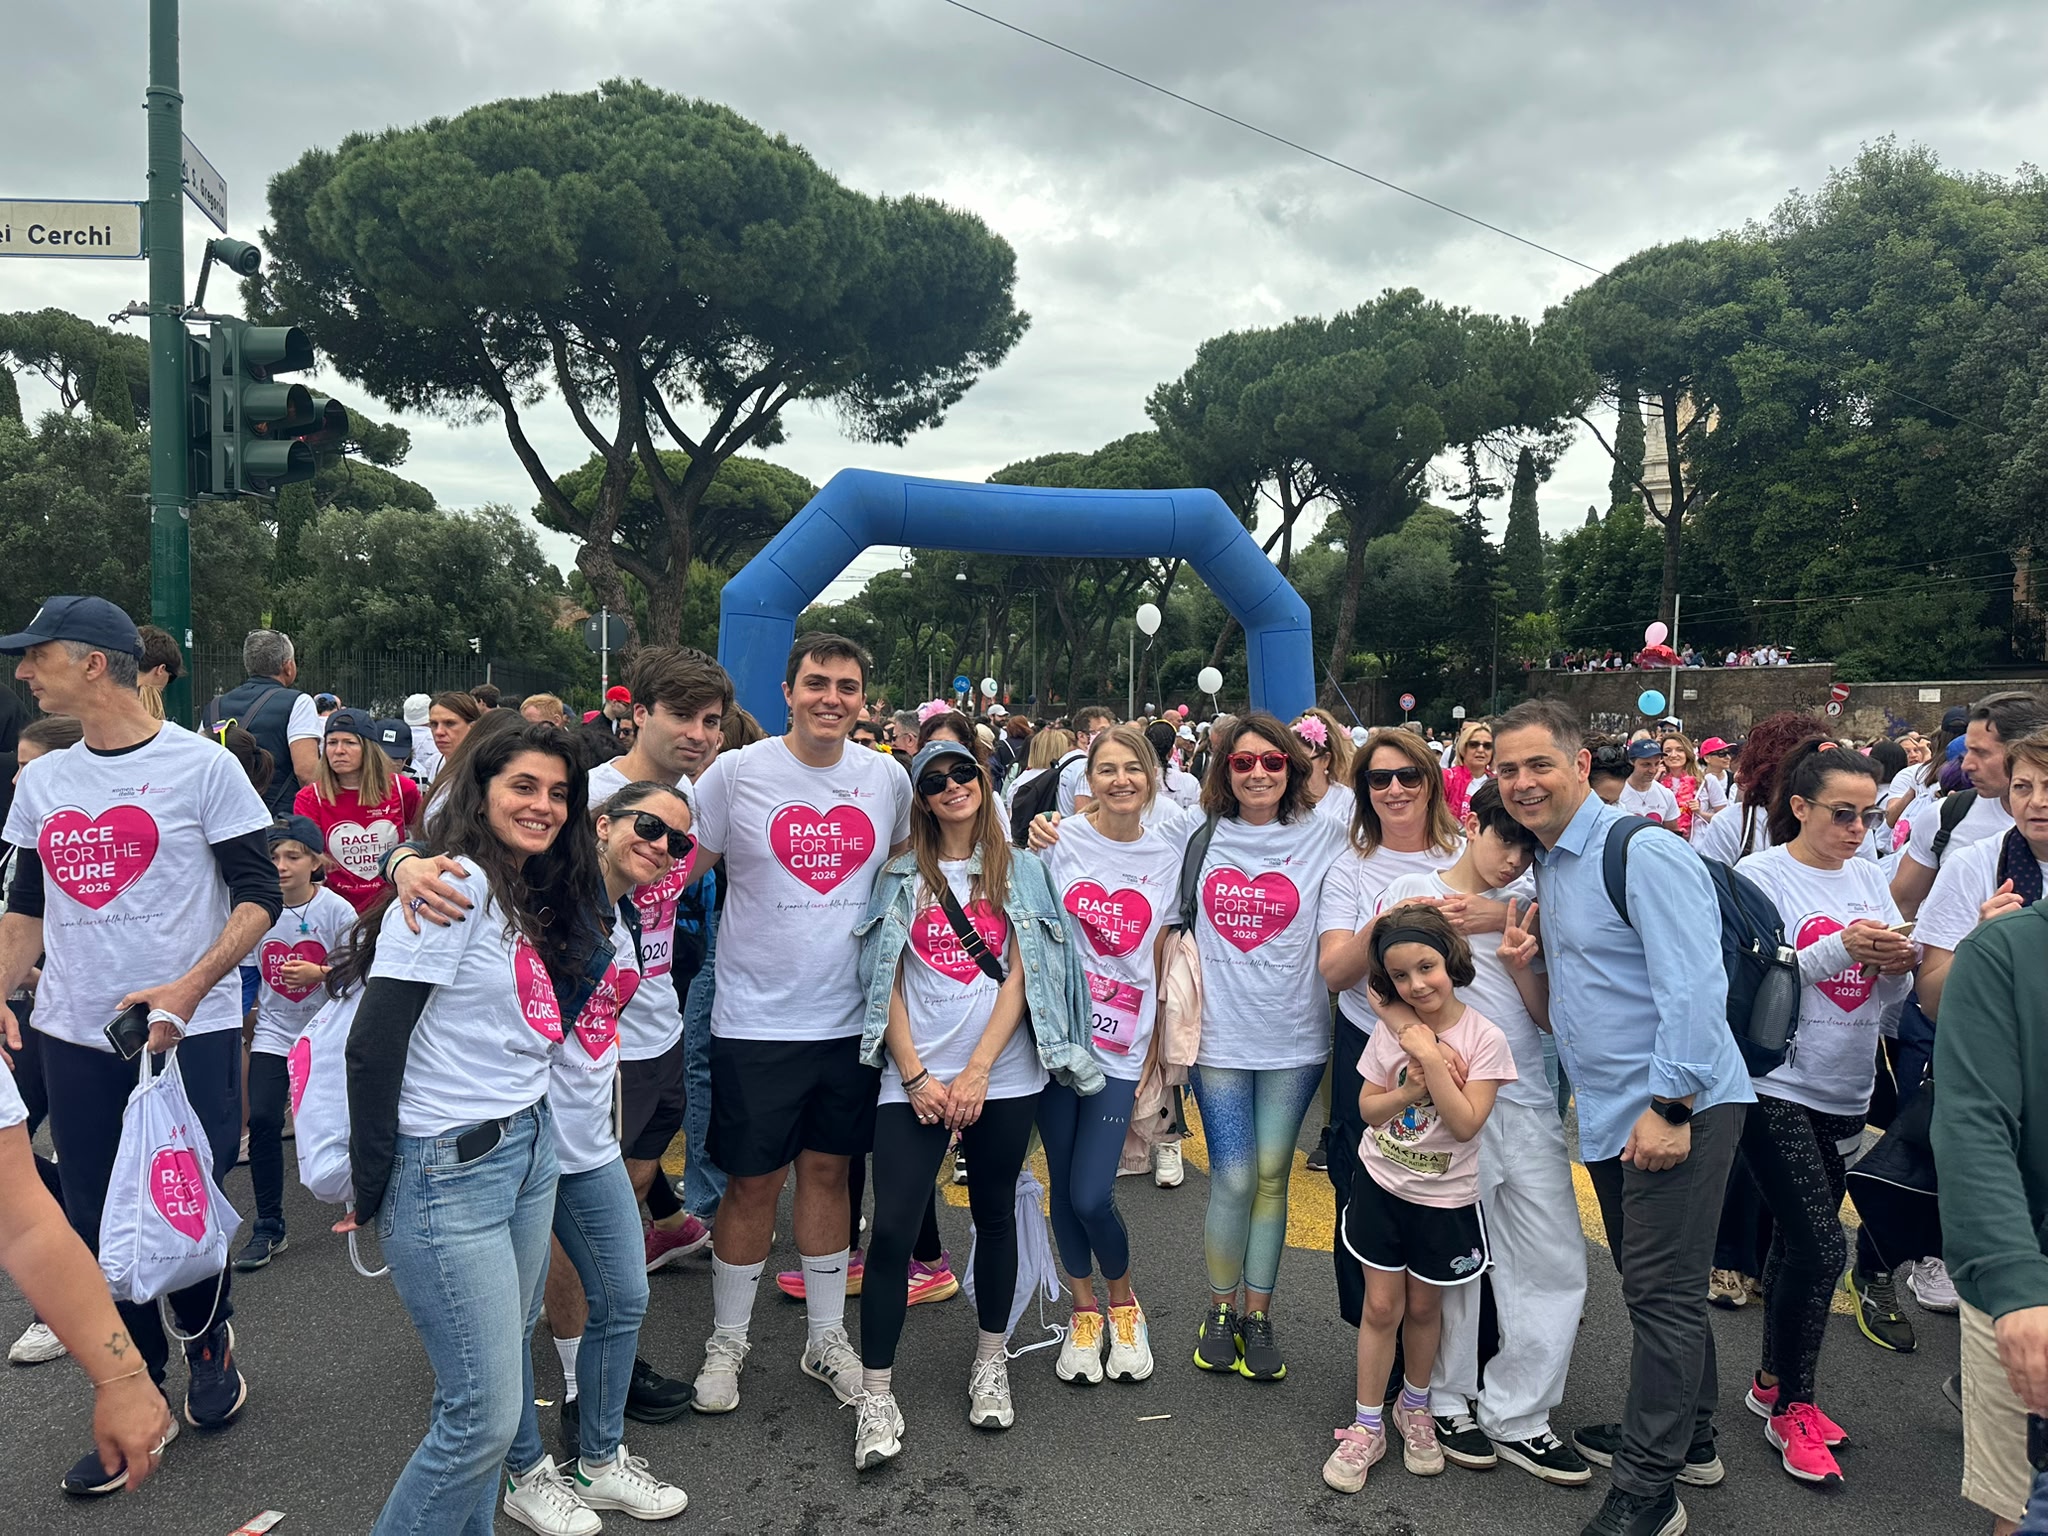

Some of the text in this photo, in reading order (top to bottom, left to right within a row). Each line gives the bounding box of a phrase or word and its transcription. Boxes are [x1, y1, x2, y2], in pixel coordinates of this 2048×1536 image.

[191, 168, 198, 190] S.
[200, 177, 224, 218] Gregorio
[27, 224, 111, 246] Cerchi
[50, 825, 114, 848] RACE
[789, 822, 842, 837] RACE
[341, 833, 379, 846] RACE
[790, 837, 864, 853] FOR THE
[51, 842, 142, 865] FOR THE
[342, 841, 393, 856] FOR THE
[343, 853, 379, 865] CURE
[790, 853, 842, 868] CURE
[55, 861, 116, 883] CURE
[811, 870, 837, 880] 2026
[78, 882, 111, 894] 2026
[1215, 883, 1266, 899] RACE
[1078, 897, 1123, 917] RACE
[1214, 898, 1286, 917] FOR THE
[1111, 917, 1141, 934] THE
[1214, 912, 1264, 928] CURE
[1232, 930, 1258, 939] 2026
[641, 941, 668, 962] 020
[1834, 986, 1861, 997] 2026
[526, 999, 558, 1019] CURE
